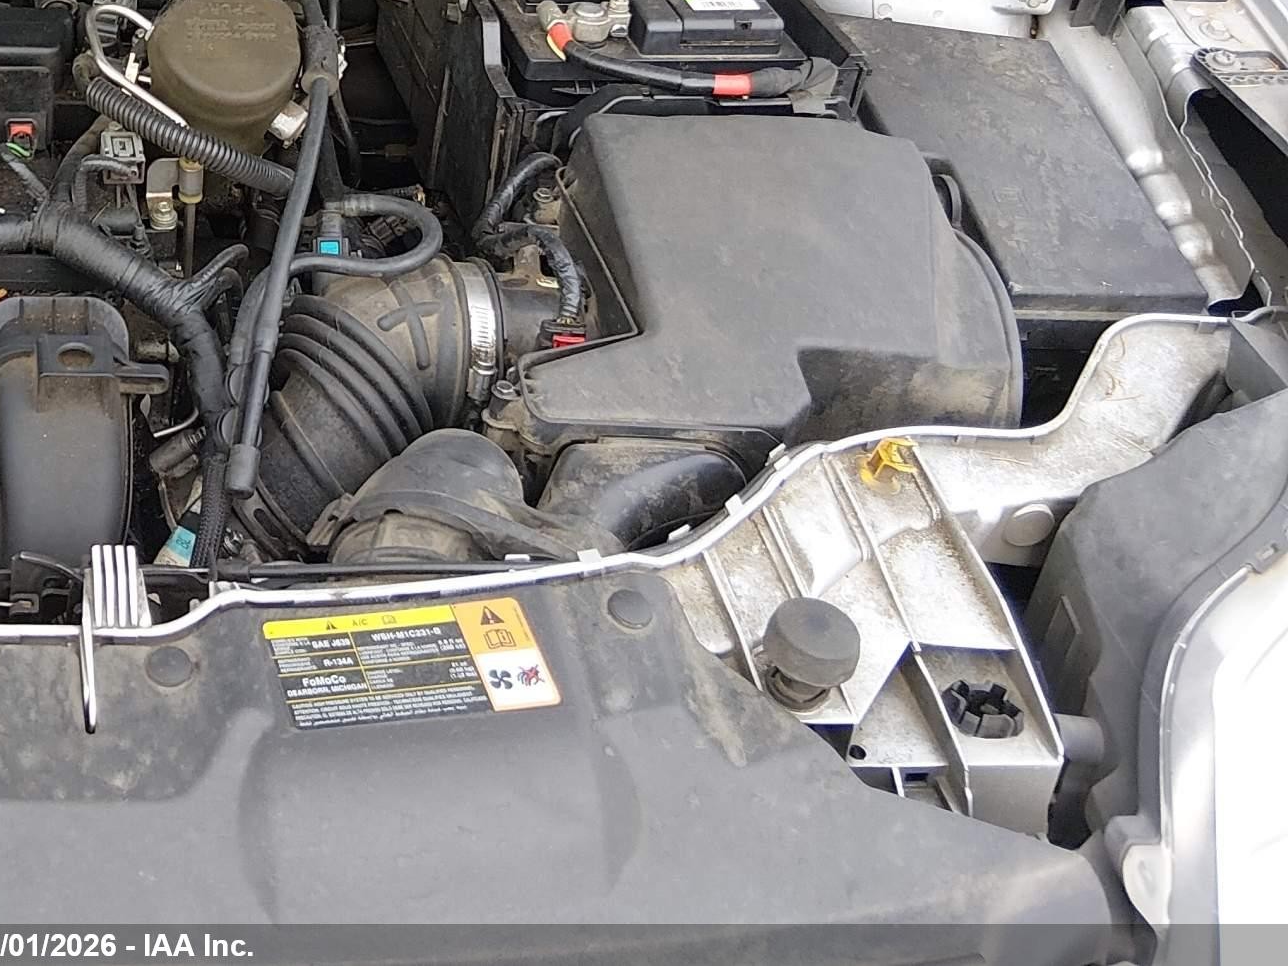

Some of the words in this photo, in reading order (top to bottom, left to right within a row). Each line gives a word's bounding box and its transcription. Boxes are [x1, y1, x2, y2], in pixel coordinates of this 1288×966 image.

[352, 618, 368, 627] A/C
[311, 639, 330, 649] SAE
[323, 657, 354, 667] R-134A
[302, 675, 347, 687] FoMoCo
[287, 686, 331, 698] DEARBORN,
[331, 683, 367, 693] MICHIGAN
